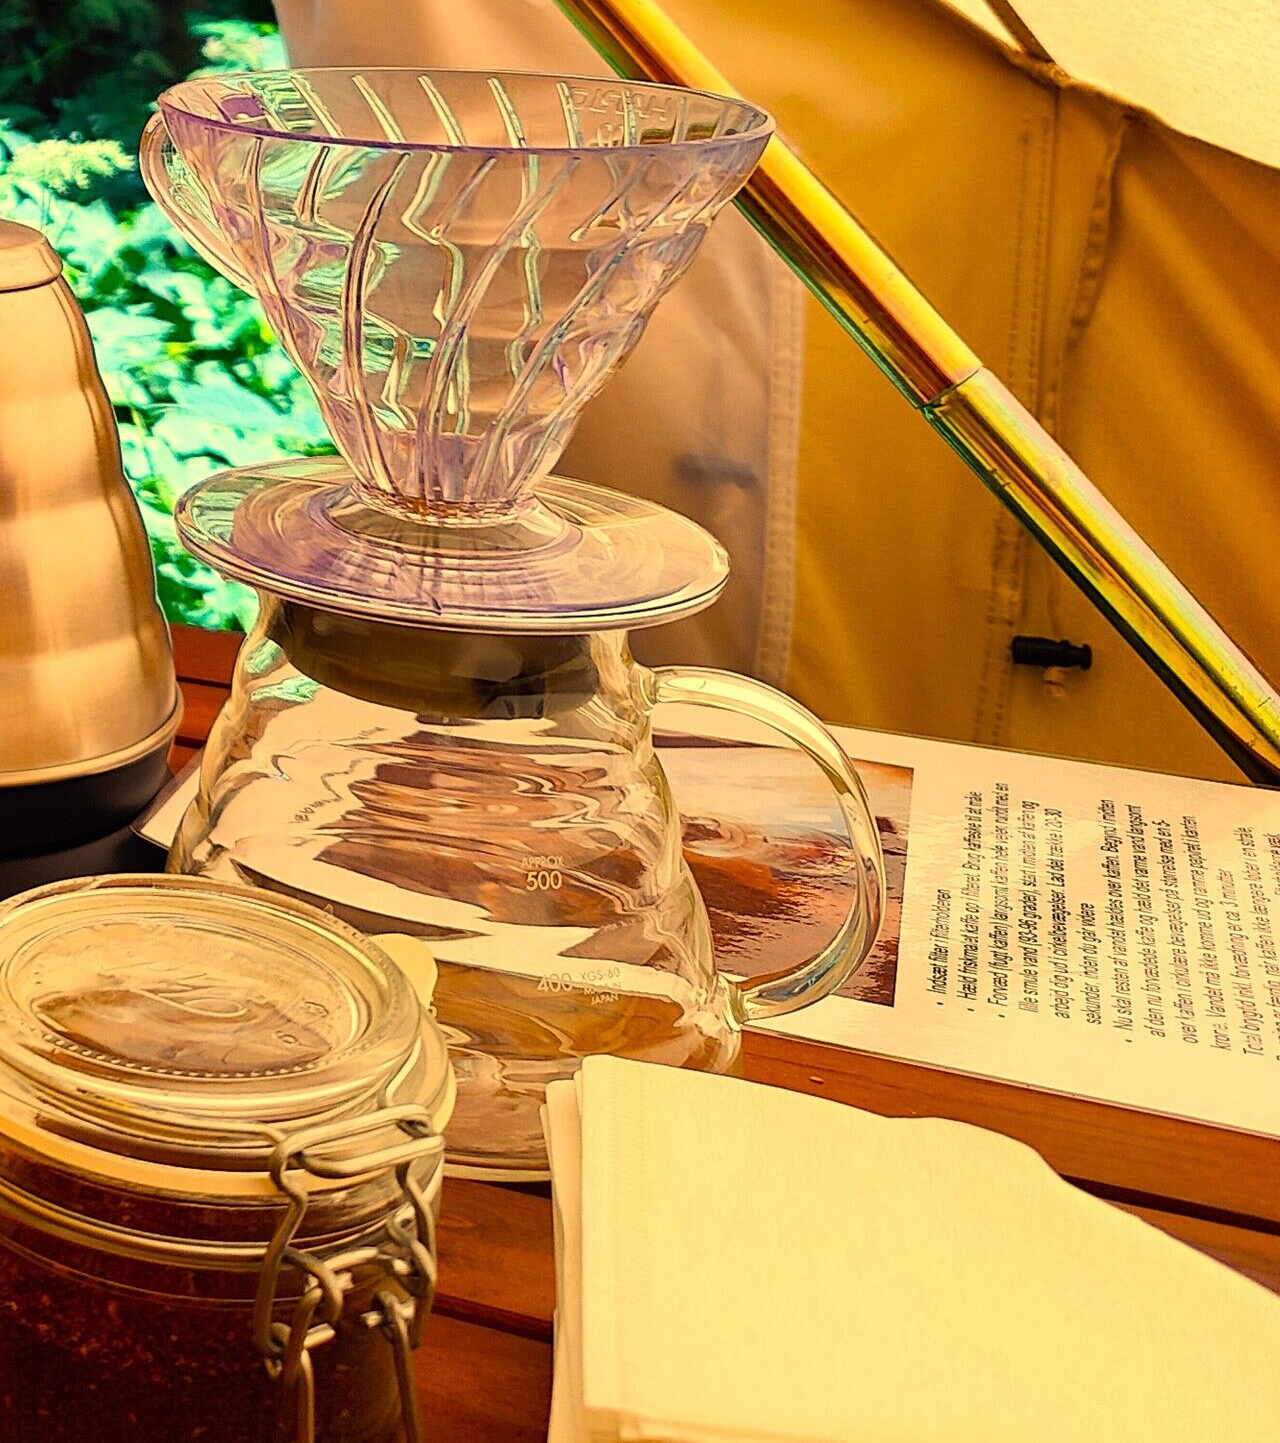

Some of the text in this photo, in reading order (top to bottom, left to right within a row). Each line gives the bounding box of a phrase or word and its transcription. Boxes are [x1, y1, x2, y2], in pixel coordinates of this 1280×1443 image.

[994, 781, 1009, 792] en
[991, 790, 1009, 807] med
[1016, 799, 1040, 811] og
[963, 806, 982, 815] at
[1043, 807, 1063, 829] 20-30
[1017, 829, 1036, 840] af
[1156, 826, 1172, 837] en
[989, 844, 1009, 861] hele
[1017, 839, 1039, 866] midten
[1125, 833, 1146, 854] vand
[1152, 835, 1173, 855] med
[1241, 846, 1257, 857] en
[961, 852, 986, 871] Brug
[1044, 857, 1065, 872] det
[1132, 854, 1149, 878] varme
[1182, 841, 1208, 870] papiret
[525, 869, 563, 892] 500
[1017, 868, 1038, 887] start
[1044, 870, 1065, 888] Lad
[1156, 854, 1178, 888] størrelse
[1106, 878, 1123, 898] over
[1130, 877, 1150, 893] det
[1189, 868, 1208, 897] ramme
[988, 884, 1013, 922] langsomt
[1131, 891, 1152, 914] hæld
[1157, 887, 1184, 901] på
[1193, 896, 1215, 909] og
[1218, 900, 1239, 908] 3
[1248, 882, 1270, 916] længere
[964, 901, 984, 914] op
[1074, 902, 1096, 927] videre
[1104, 897, 1125, 928] hældes
[1190, 907, 1212, 921] ud
[959, 913, 979, 935] kaffe
[1138, 913, 1159, 926] og
[1162, 899, 1188, 947] bevægelser
[1226, 920, 1243, 932] er
[1251, 915, 1272, 934] ikke
[987, 920, 1013, 951] kaffen)
[1074, 926, 1102, 944] går
[1105, 926, 1127, 956] vandet
[1134, 925, 1156, 947] kaffe
[1196, 920, 1216, 952] komme
[927, 942, 949, 963] filter
[1017, 944, 1038, 967] vand
[1076, 941, 1098, 955] du
[1225, 932, 1250, 979] forvædning
[1254, 934, 1280, 961] kaffen
[987, 949, 1014, 972] (fugt
[1047, 959, 1068, 974] ud
[1077, 954, 1098, 980] inden
[1106, 954, 1128, 967] af
[1137, 947, 1160, 993] forvædede
[1168, 947, 1191, 987] cirkulære
[1197, 952, 1219, 971] ikke
[1257, 959, 1280, 977] når
[536, 972, 573, 994] 400
[925, 962, 948, 995] Indsæt
[955, 973, 978, 1001] Hæld
[986, 969, 1008, 1007] Forvæd
[1017, 967, 1038, 996] smule
[1048, 973, 1074, 989] dig
[1110, 967, 1131, 996] resten
[1197, 970, 1221, 986] må
[1017, 996, 1039, 1013] lille
[1048, 988, 1075, 1019] arbejd
[1110, 994, 1132, 1016] skal
[1146, 993, 1162, 1007] nu
[1172, 992, 1195, 1021] kaffen
[1202, 985, 1226, 1018] Vandet
[1111, 1015, 1133, 1031] Nu
[1143, 1007, 1165, 1026] den
[1234, 998, 1264, 1031] brygtid
[1142, 1023, 1166, 1038] af
[1180, 1021, 1198, 1044] over
[1239, 1030, 1264, 1056] Total
